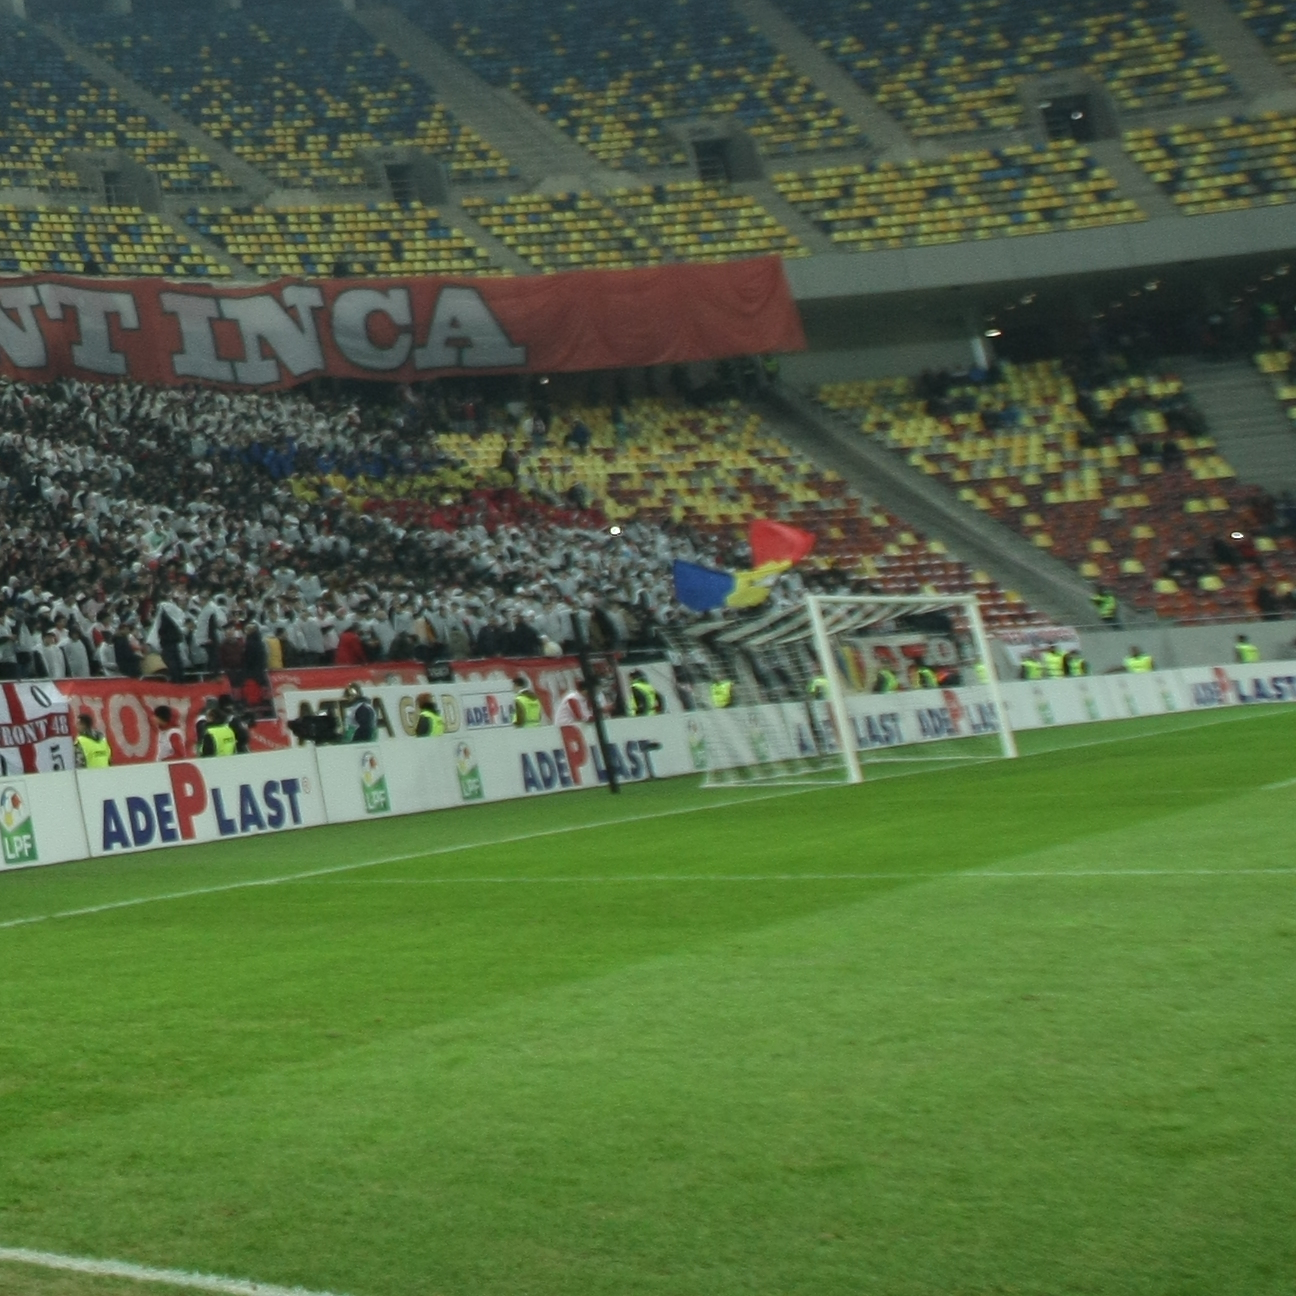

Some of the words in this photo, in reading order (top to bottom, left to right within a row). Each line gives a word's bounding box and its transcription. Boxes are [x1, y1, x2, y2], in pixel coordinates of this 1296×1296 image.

[161, 284, 528, 387] INCA
[3, 834, 32, 859] LPF
[102, 761, 303, 852] ADEPLAST
